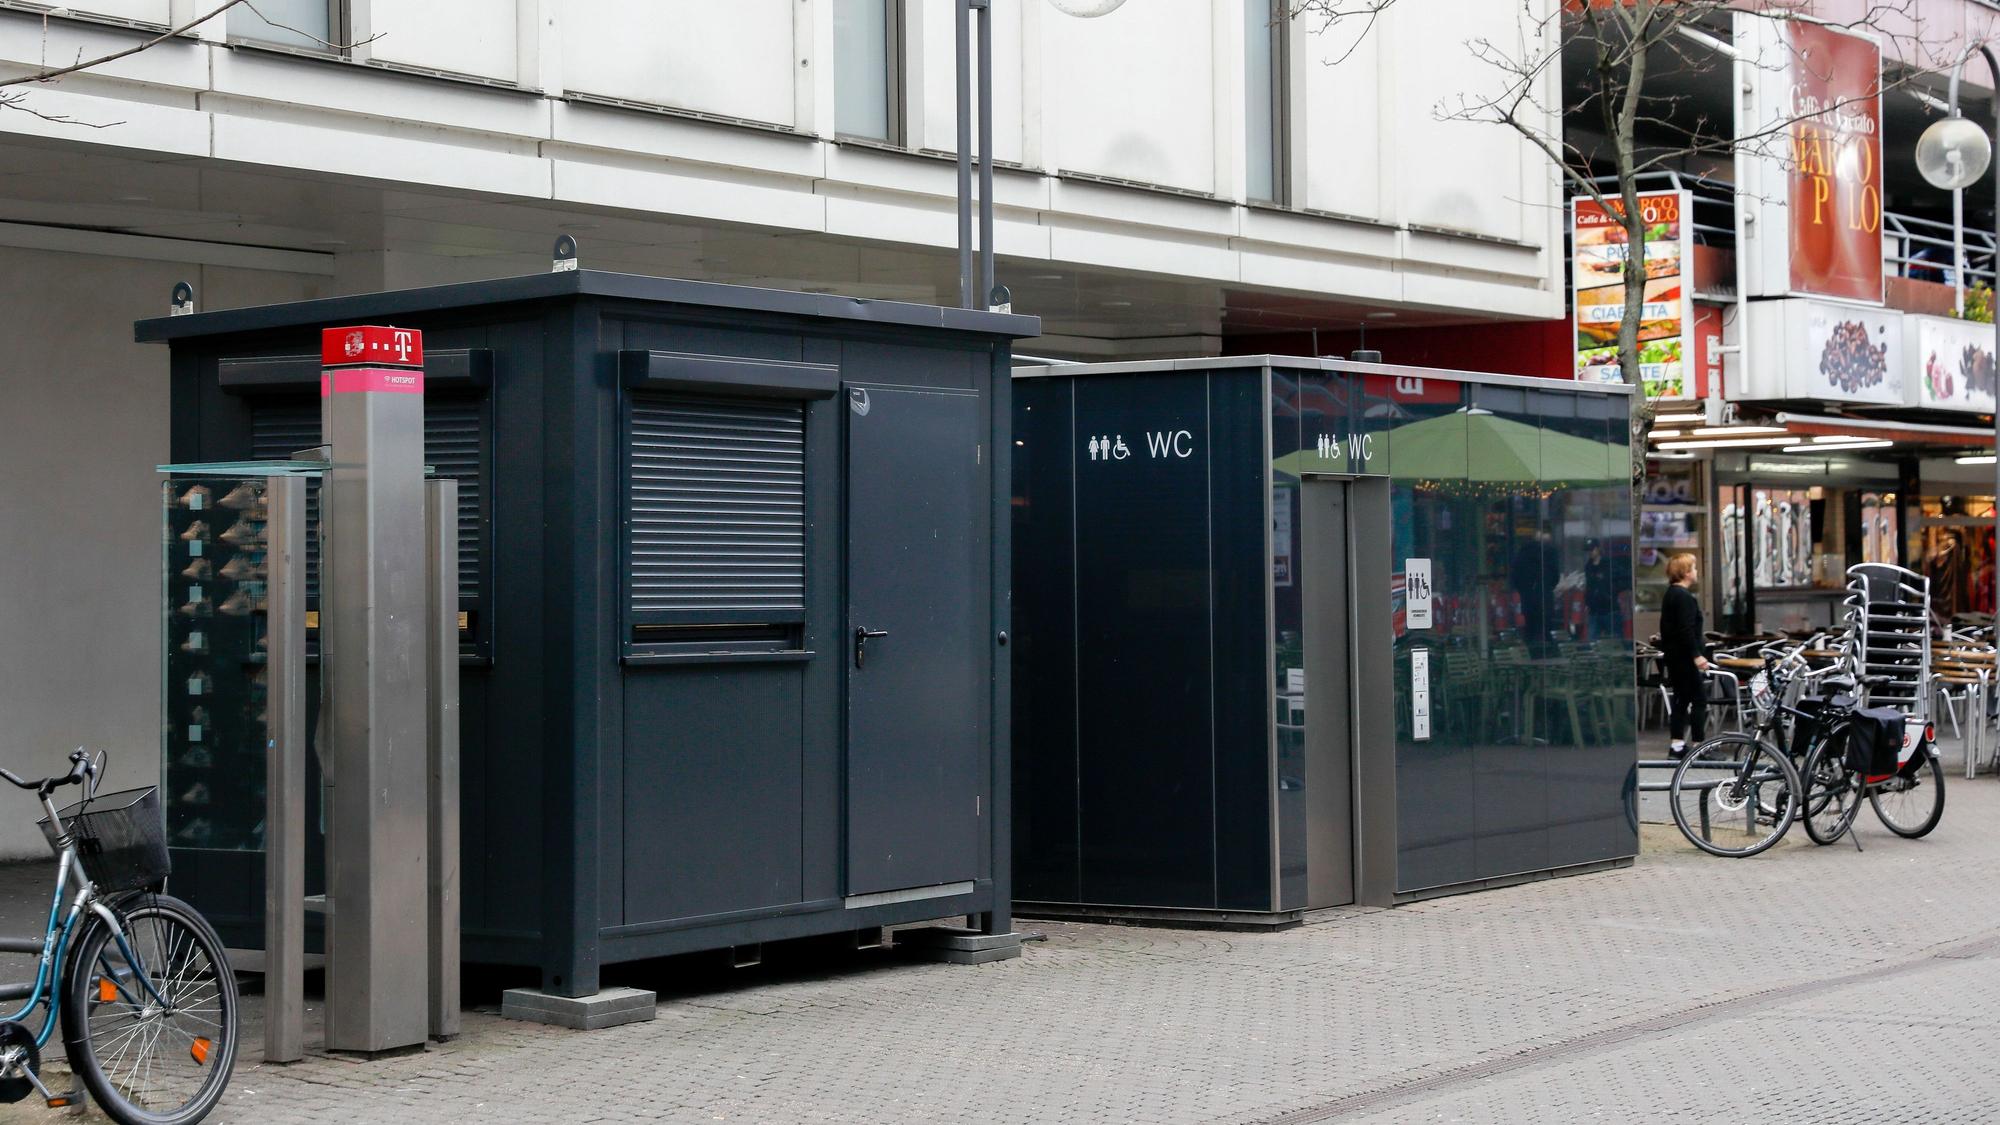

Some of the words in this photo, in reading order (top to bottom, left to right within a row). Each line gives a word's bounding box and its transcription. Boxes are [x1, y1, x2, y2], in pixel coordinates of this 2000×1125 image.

[1823, 99, 1833, 125] &
[1813, 175, 1879, 233] PLO
[394, 331, 412, 361] T
[391, 377, 415, 385] HOTSPOT
[1600, 366, 1660, 380] SATE
[1146, 430, 1193, 459] WC
[1348, 433, 1373, 461] WC
